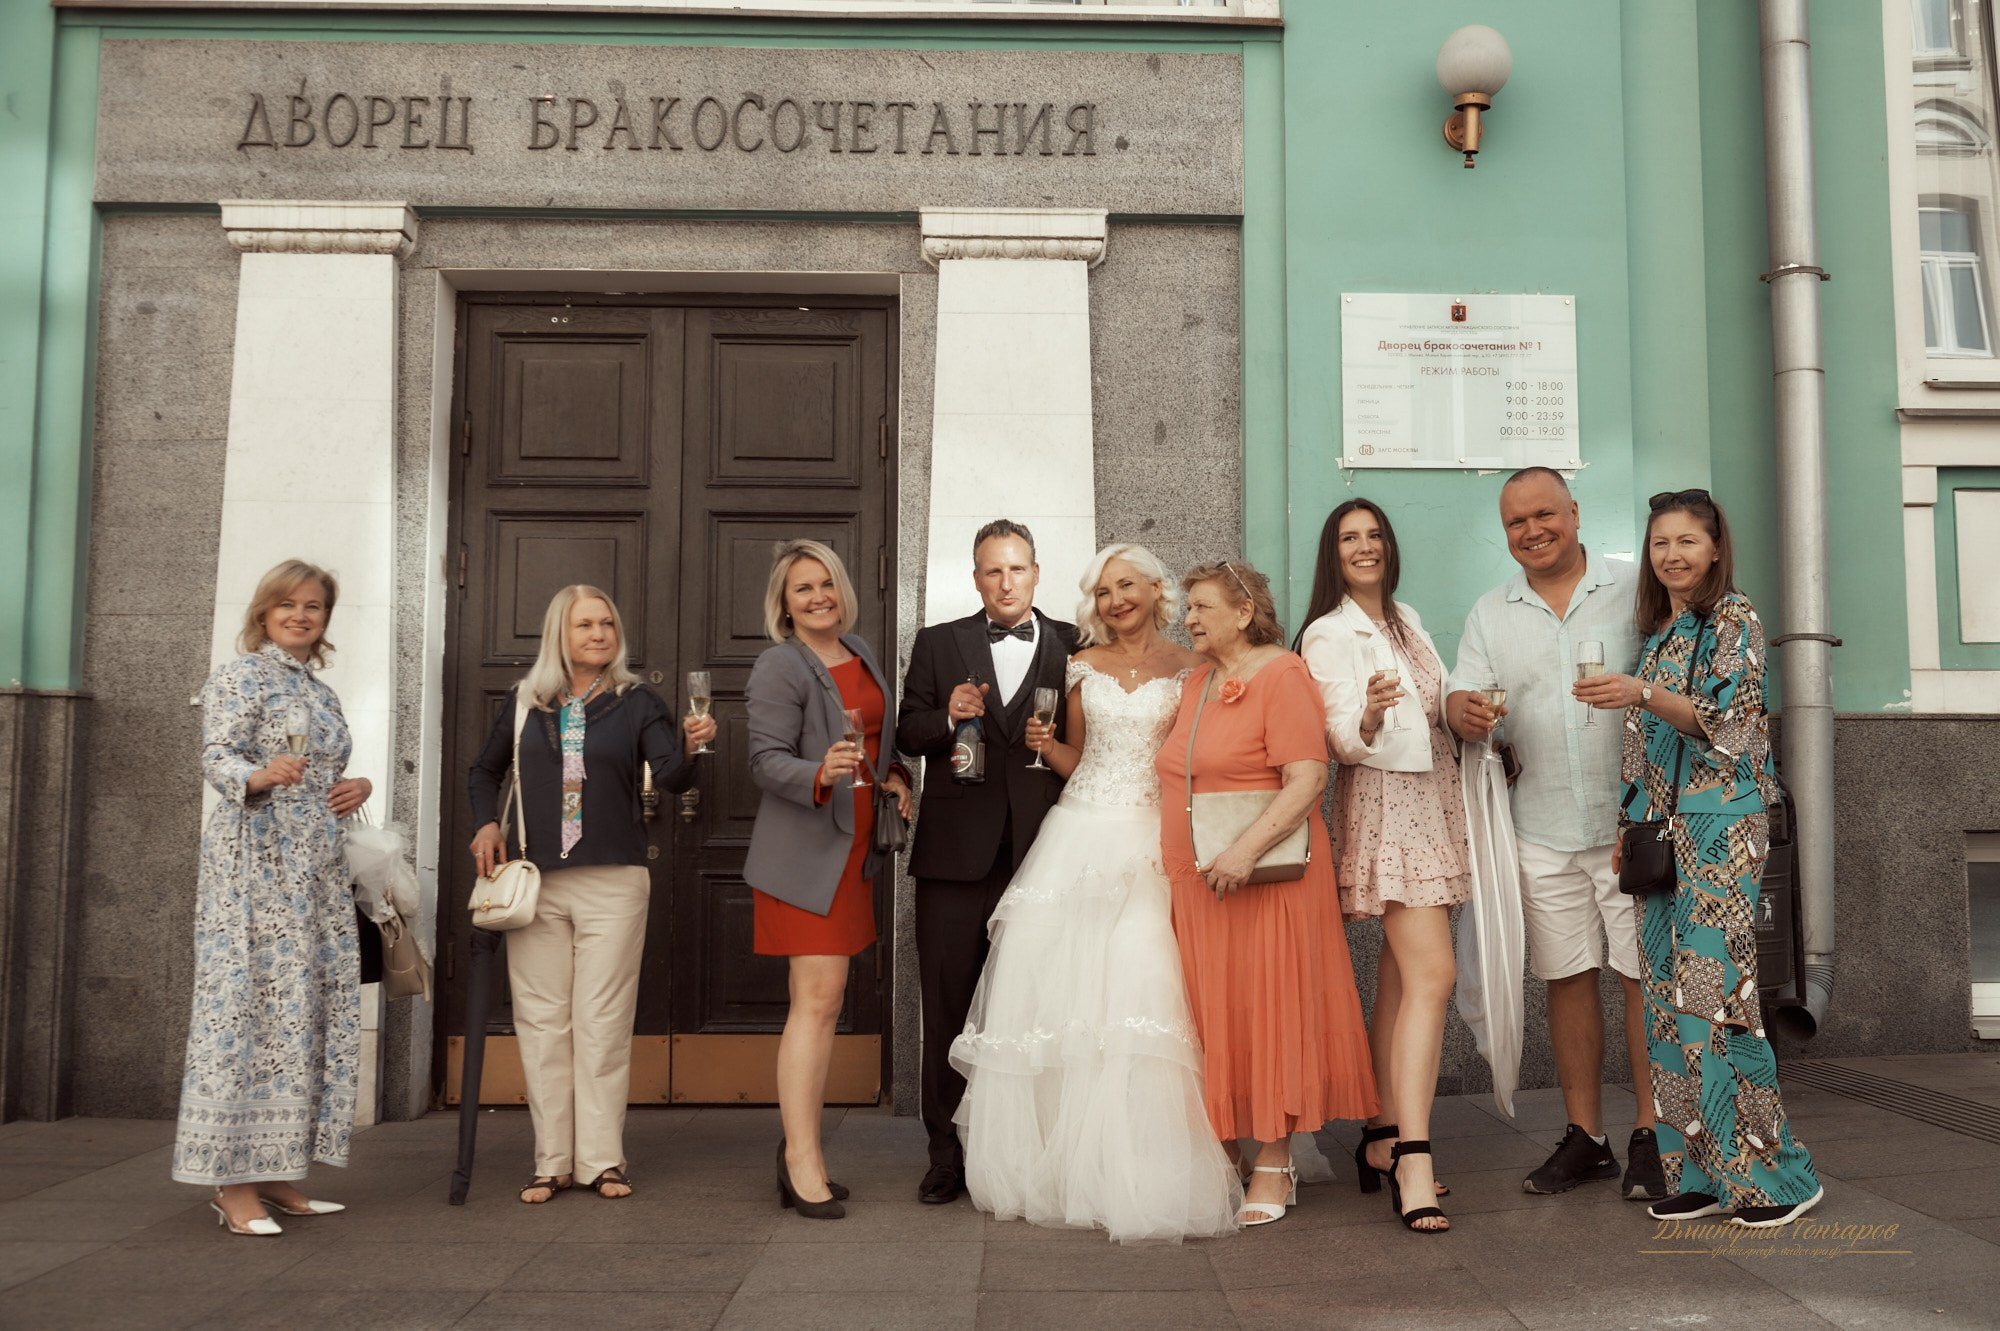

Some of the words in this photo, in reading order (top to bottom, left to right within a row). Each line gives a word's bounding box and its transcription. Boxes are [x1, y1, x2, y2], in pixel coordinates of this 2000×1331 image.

[237, 92, 474, 155] ДВОРЕЦ
[527, 95, 1097, 156] БРАКОСОЧЕТАНИЯ
[1378, 340, 1421, 352] Дворец
[1423, 340, 1516, 352] бракосочетания
[1519, 341, 1533, 351] №
[1537, 341, 1542, 350] 1
[1420, 366, 1458, 376] РЕЖИМ
[1461, 367, 1500, 376] РАБОТЫ
[1505, 381, 1528, 391] 9:00
[1537, 381, 1564, 391] 18:00
[1506, 396, 1528, 405] 9:00
[1536, 396, 1564, 405] 20:00
[1506, 411, 1528, 420] 9:00
[1536, 411, 1564, 420] 23:59
[1500, 426, 1529, 436] 00:00
[1538, 426, 1565, 436] 19:00
